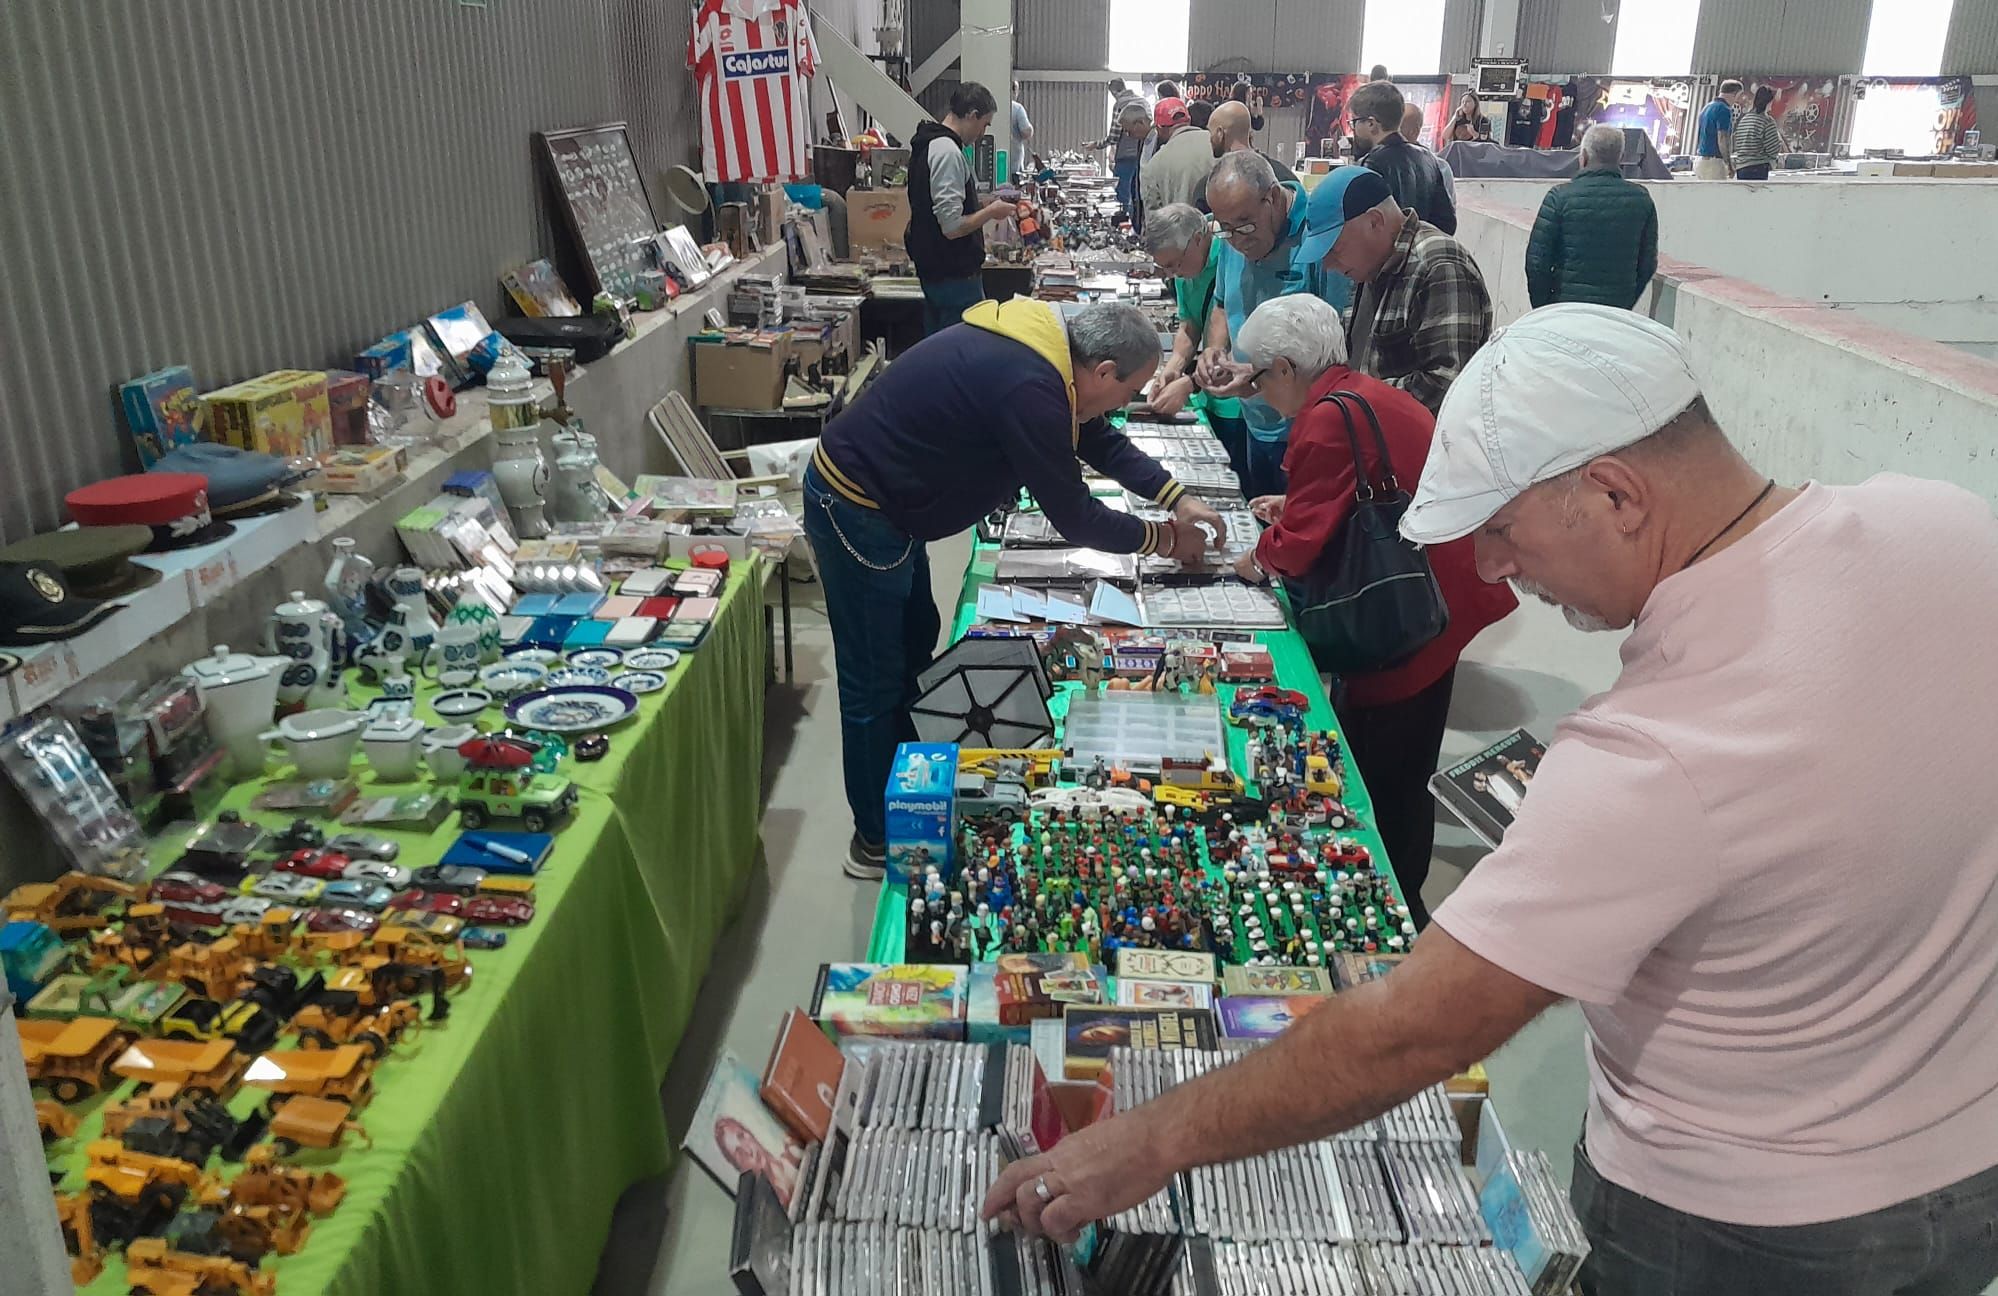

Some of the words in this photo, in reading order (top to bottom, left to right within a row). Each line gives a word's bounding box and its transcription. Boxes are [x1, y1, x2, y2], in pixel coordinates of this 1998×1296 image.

[1178, 80, 1212, 100] Happy
[1448, 754, 1486, 780] FREDDIE
[1484, 732, 1522, 760] MERCURY
[888, 800, 947, 813] playmobil
